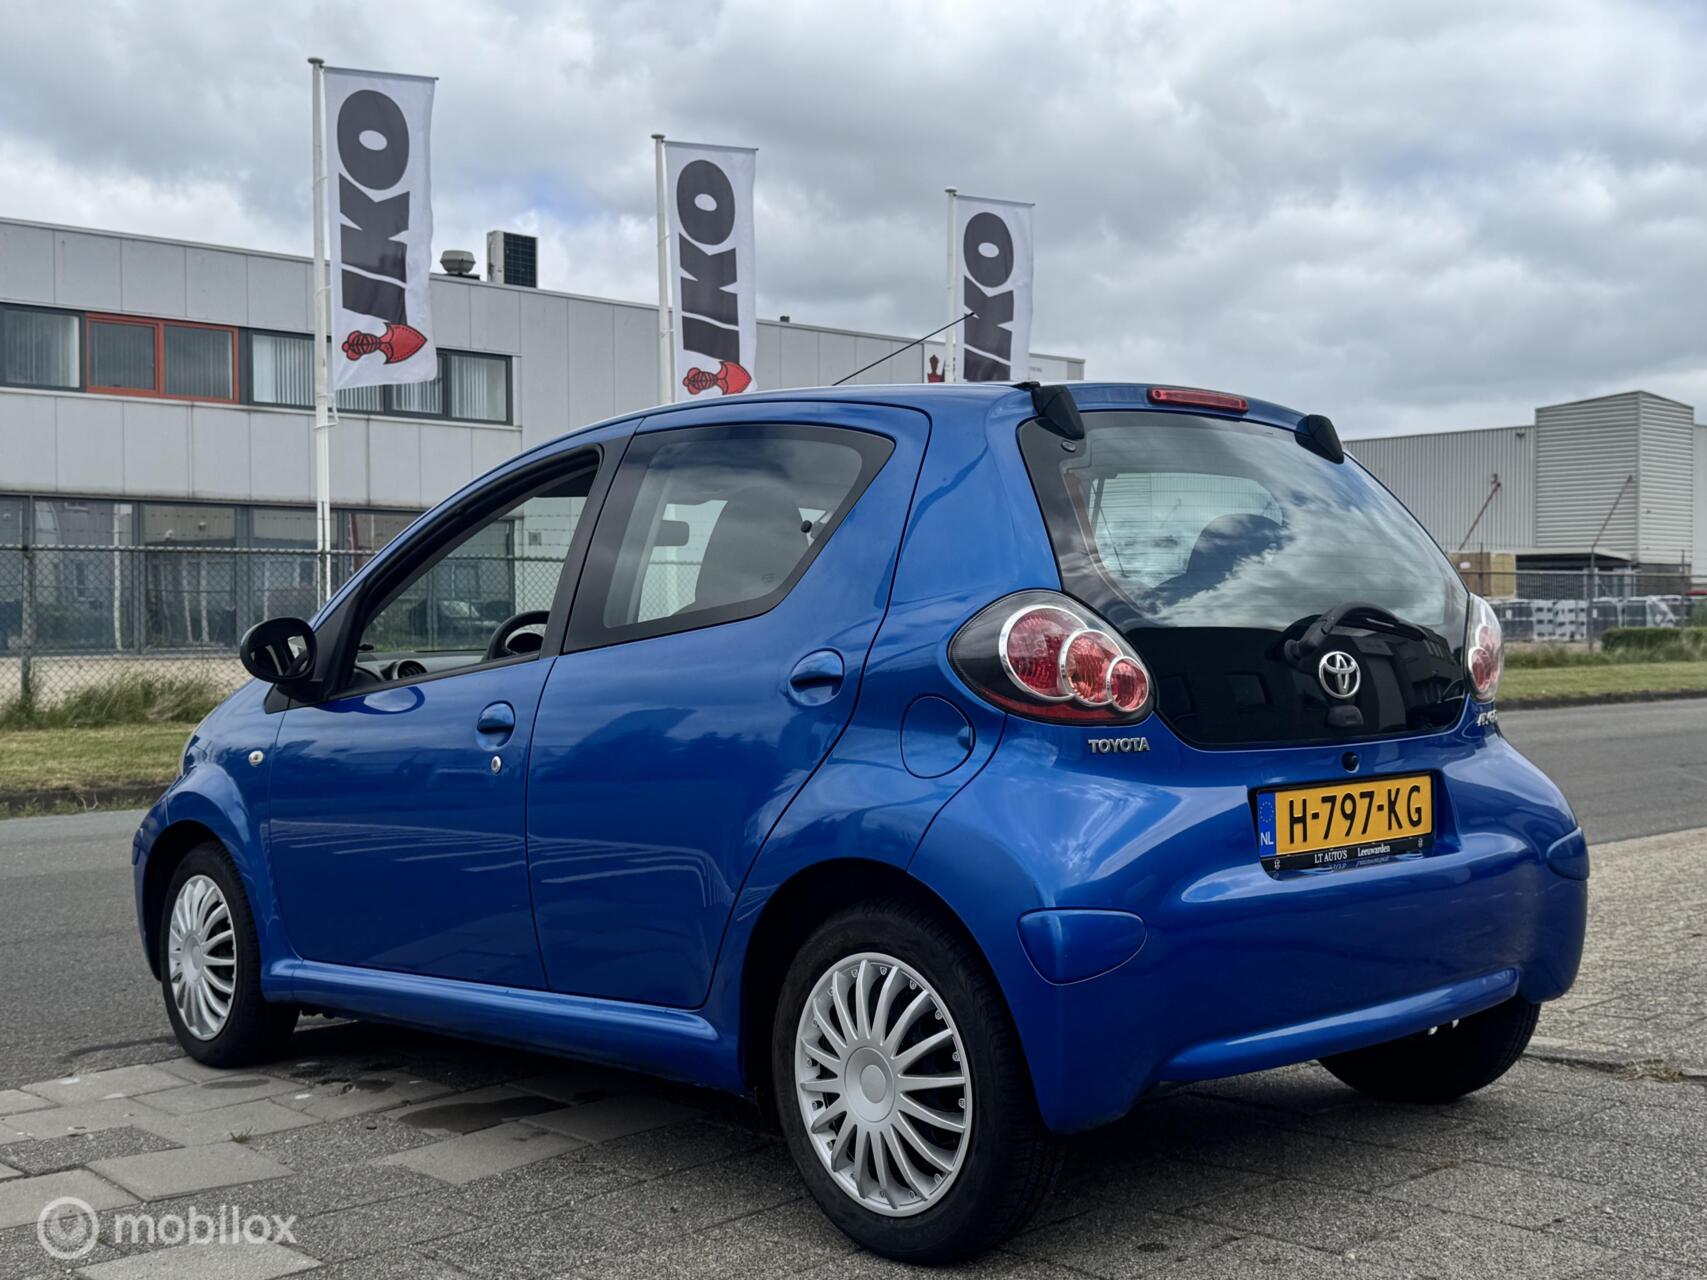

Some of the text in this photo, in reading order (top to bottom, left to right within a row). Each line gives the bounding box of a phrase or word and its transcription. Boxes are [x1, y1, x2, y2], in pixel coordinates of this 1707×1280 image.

[337, 90, 410, 323] IKO
[677, 160, 740, 360] IKO
[963, 212, 1014, 382] IKO
[1088, 737, 1150, 753] TOYOTA
[1260, 832, 1274, 846] NL
[1289, 785, 1422, 844] H-797-KG
[1314, 844, 1391, 864] LT AUTO'S Leeuwarden
